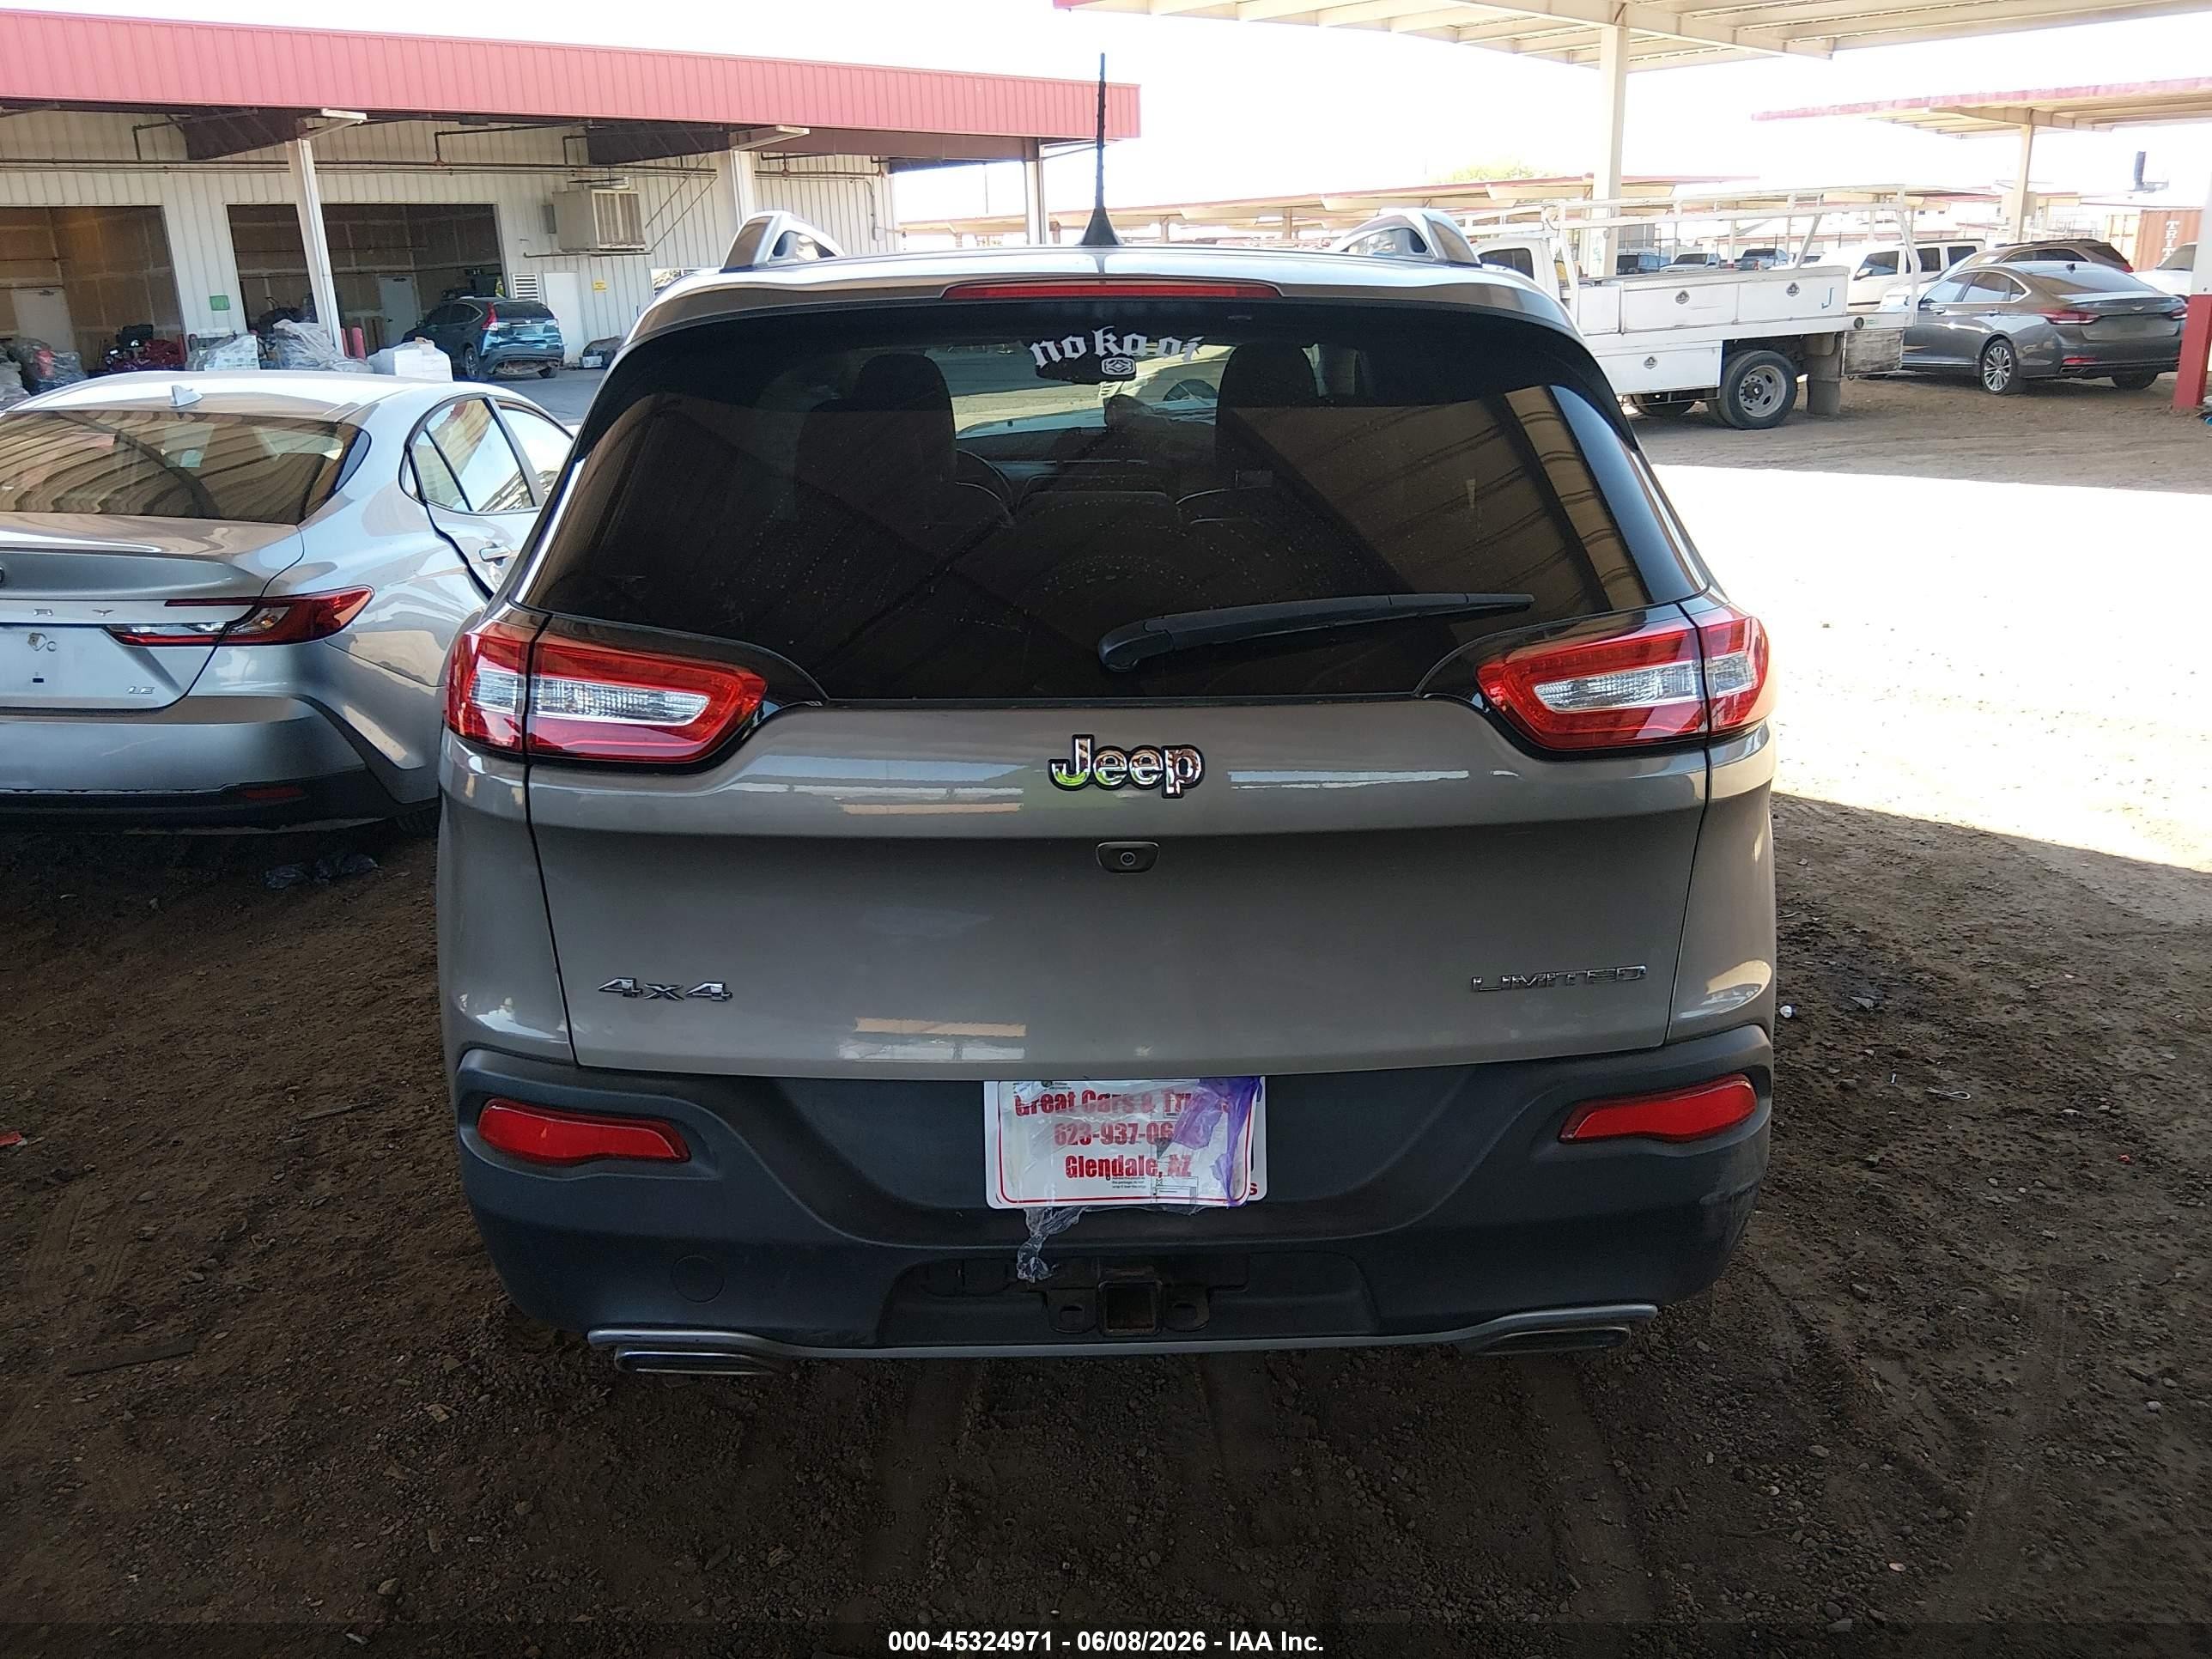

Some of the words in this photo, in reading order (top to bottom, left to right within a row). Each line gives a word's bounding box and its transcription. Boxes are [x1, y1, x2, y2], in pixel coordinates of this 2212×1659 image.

[2161, 220, 2181, 258] TRIT
[1030, 335, 1087, 368] no
[1091, 325, 1148, 357] ka
[1048, 734, 1205, 799] Jeep
[598, 977, 733, 1001] 4x4
[1471, 964, 1648, 993] LIMITED
[1014, 1091, 1076, 1116] Great
[1082, 1090, 1134, 1114] Cars
[1065, 1154, 1162, 1178] Glendale,
[1167, 1154, 1192, 1177] AZ
